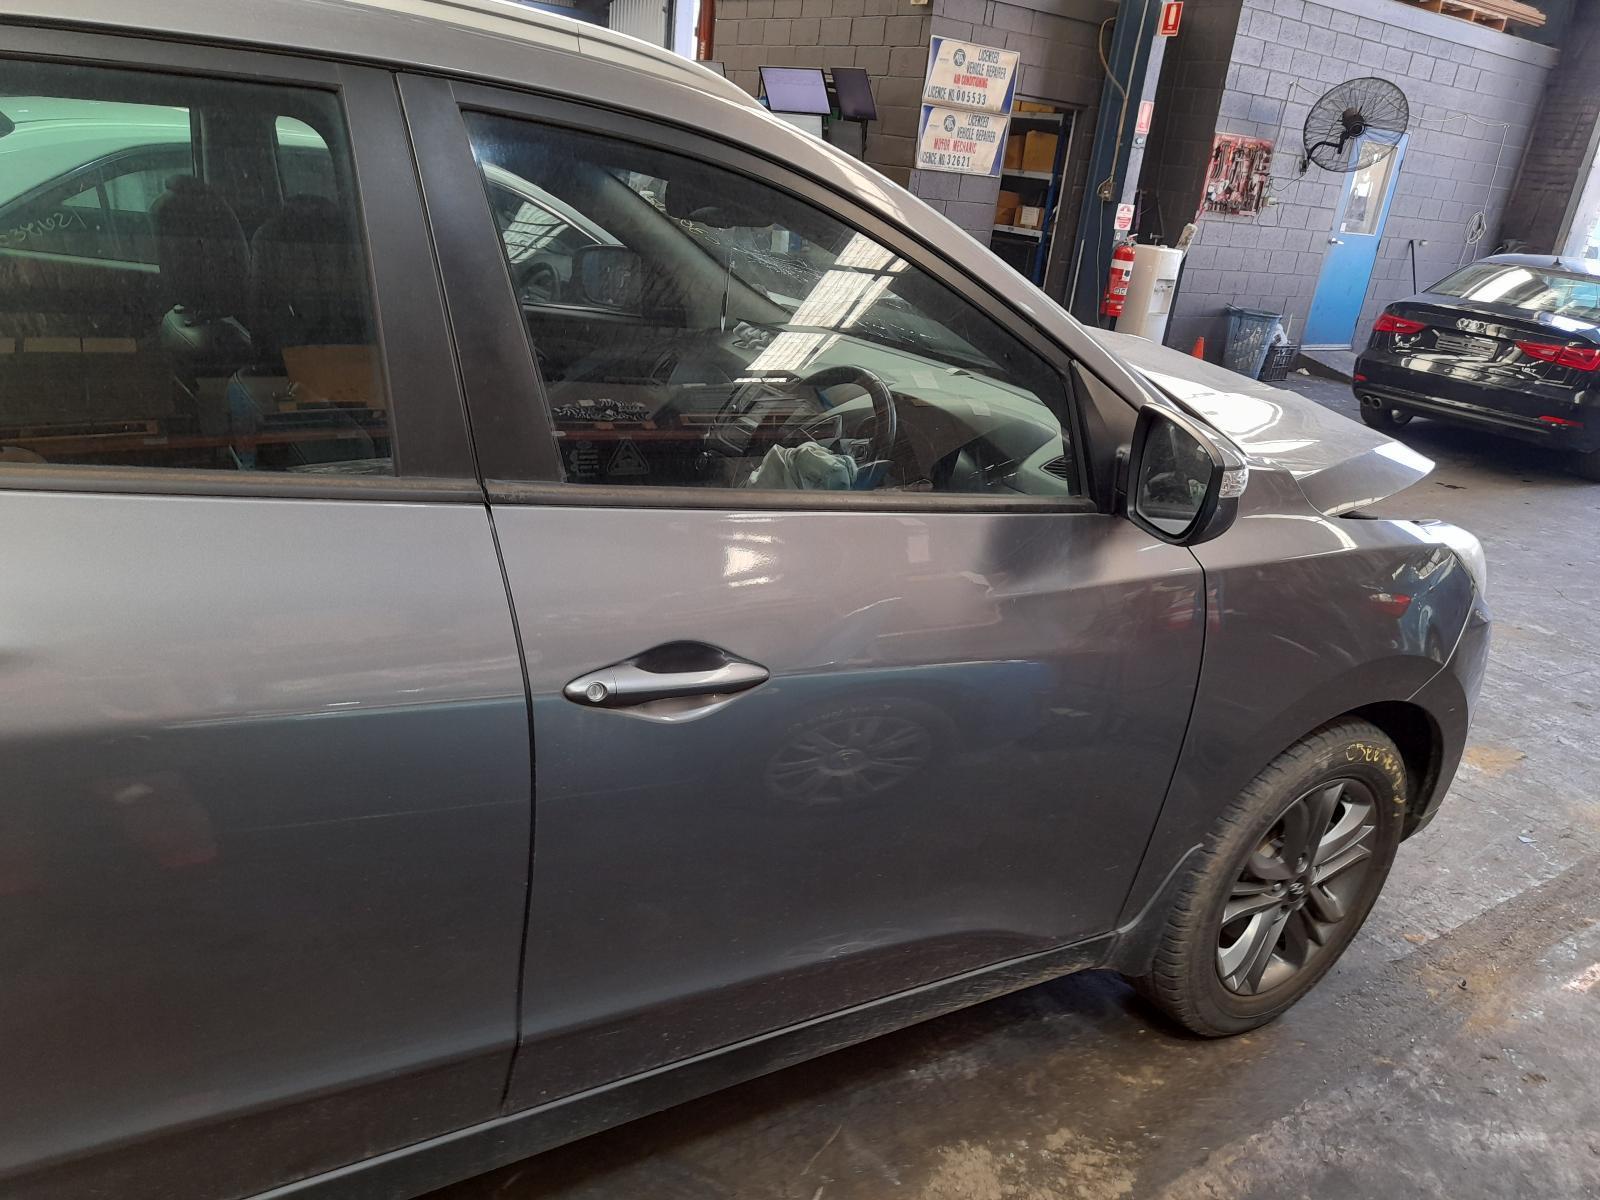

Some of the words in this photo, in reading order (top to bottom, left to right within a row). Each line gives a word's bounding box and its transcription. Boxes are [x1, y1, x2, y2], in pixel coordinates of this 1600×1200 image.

[934, 138, 951, 151] MOTOR
[920, 152, 938, 165] CENCE
[946, 154, 970, 167] 32621
